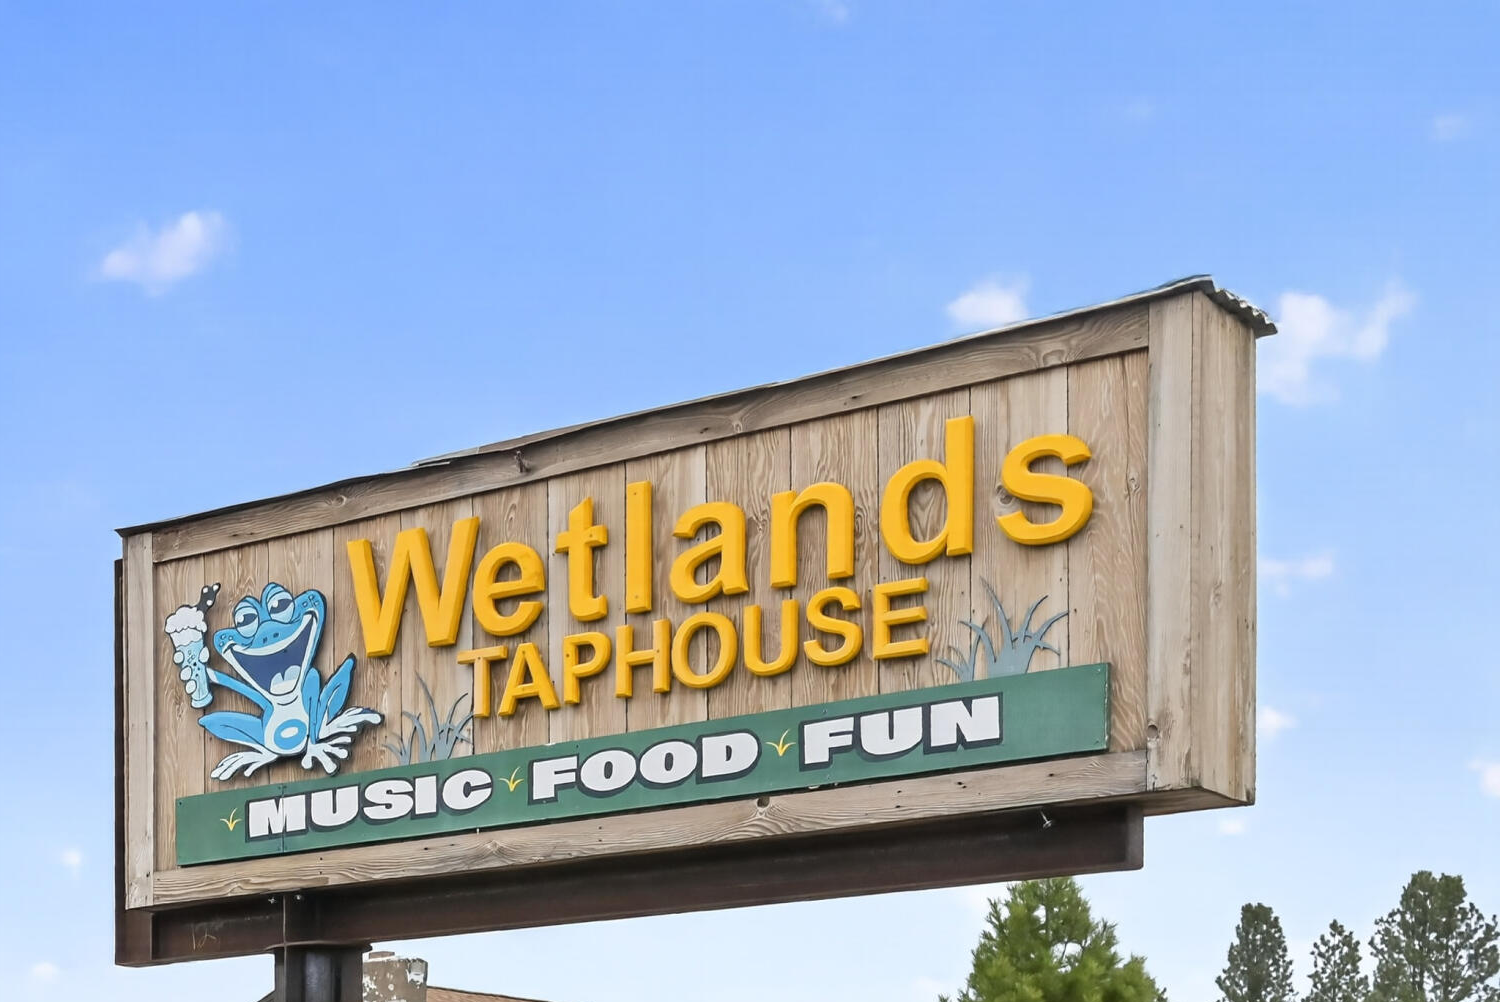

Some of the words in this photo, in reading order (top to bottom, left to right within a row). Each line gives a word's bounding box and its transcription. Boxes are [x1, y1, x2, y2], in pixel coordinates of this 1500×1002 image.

[346, 415, 1093, 658] Wetlands
[457, 576, 929, 718] TAPHOUSE
[248, 768, 492, 839] MUSIC
[531, 731, 760, 802] FOOD
[802, 695, 1000, 765] FUN
